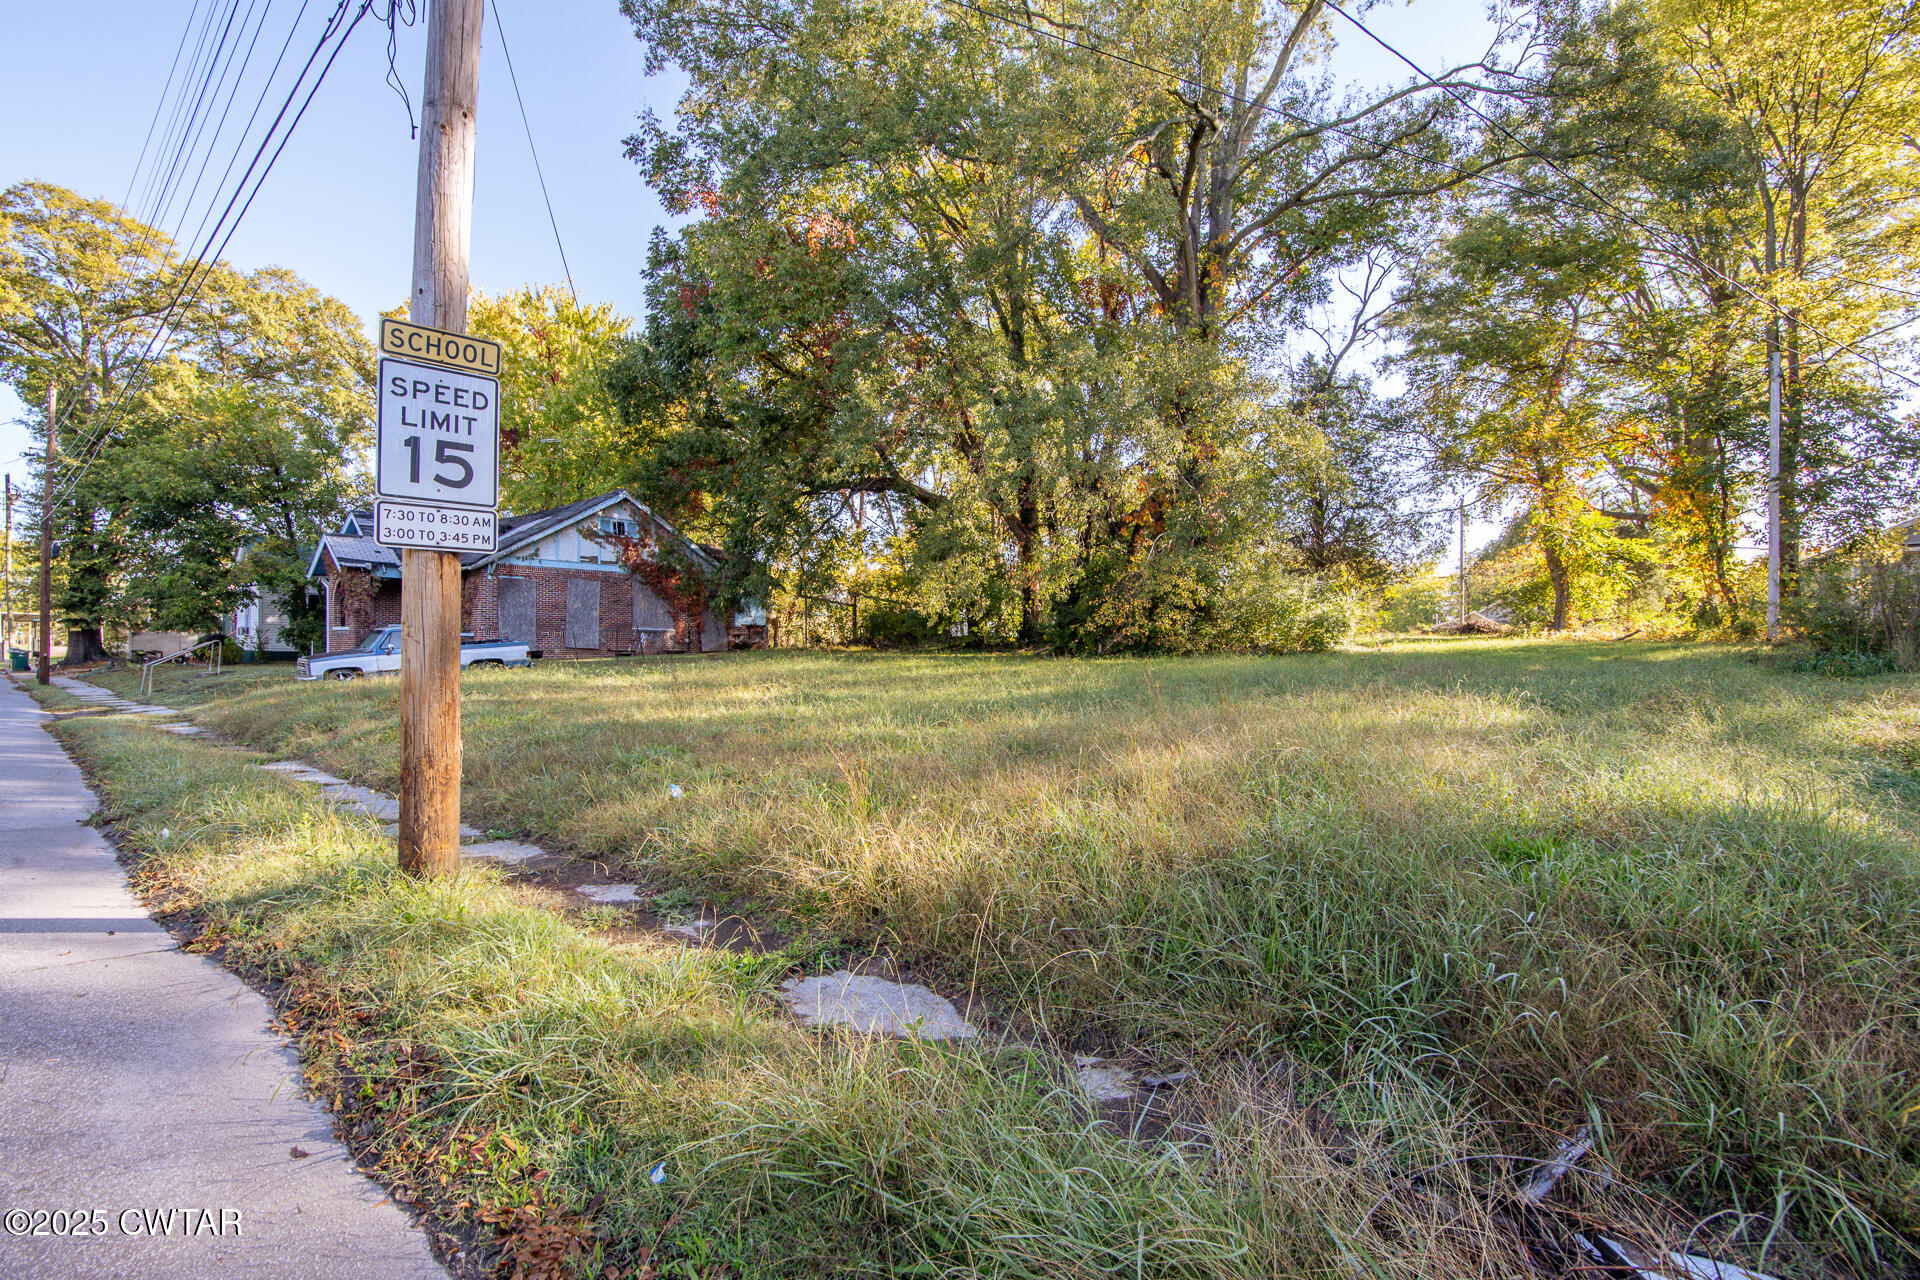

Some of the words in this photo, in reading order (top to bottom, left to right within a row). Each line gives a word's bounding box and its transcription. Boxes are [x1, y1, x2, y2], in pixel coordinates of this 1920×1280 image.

[390, 328, 493, 367] SCHOOL
[390, 377, 488, 410] SPEED
[401, 406, 477, 435] LIMIT
[404, 436, 474, 489] 15
[383, 509, 414, 521] 7:30
[419, 512, 434, 522] TO
[440, 514, 469, 525] 8:30
[473, 517, 491, 527] AM
[384, 528, 414, 539] 3:00
[419, 530, 434, 540] TO
[440, 532, 468, 543] 3:45
[473, 535, 490, 544] PM
